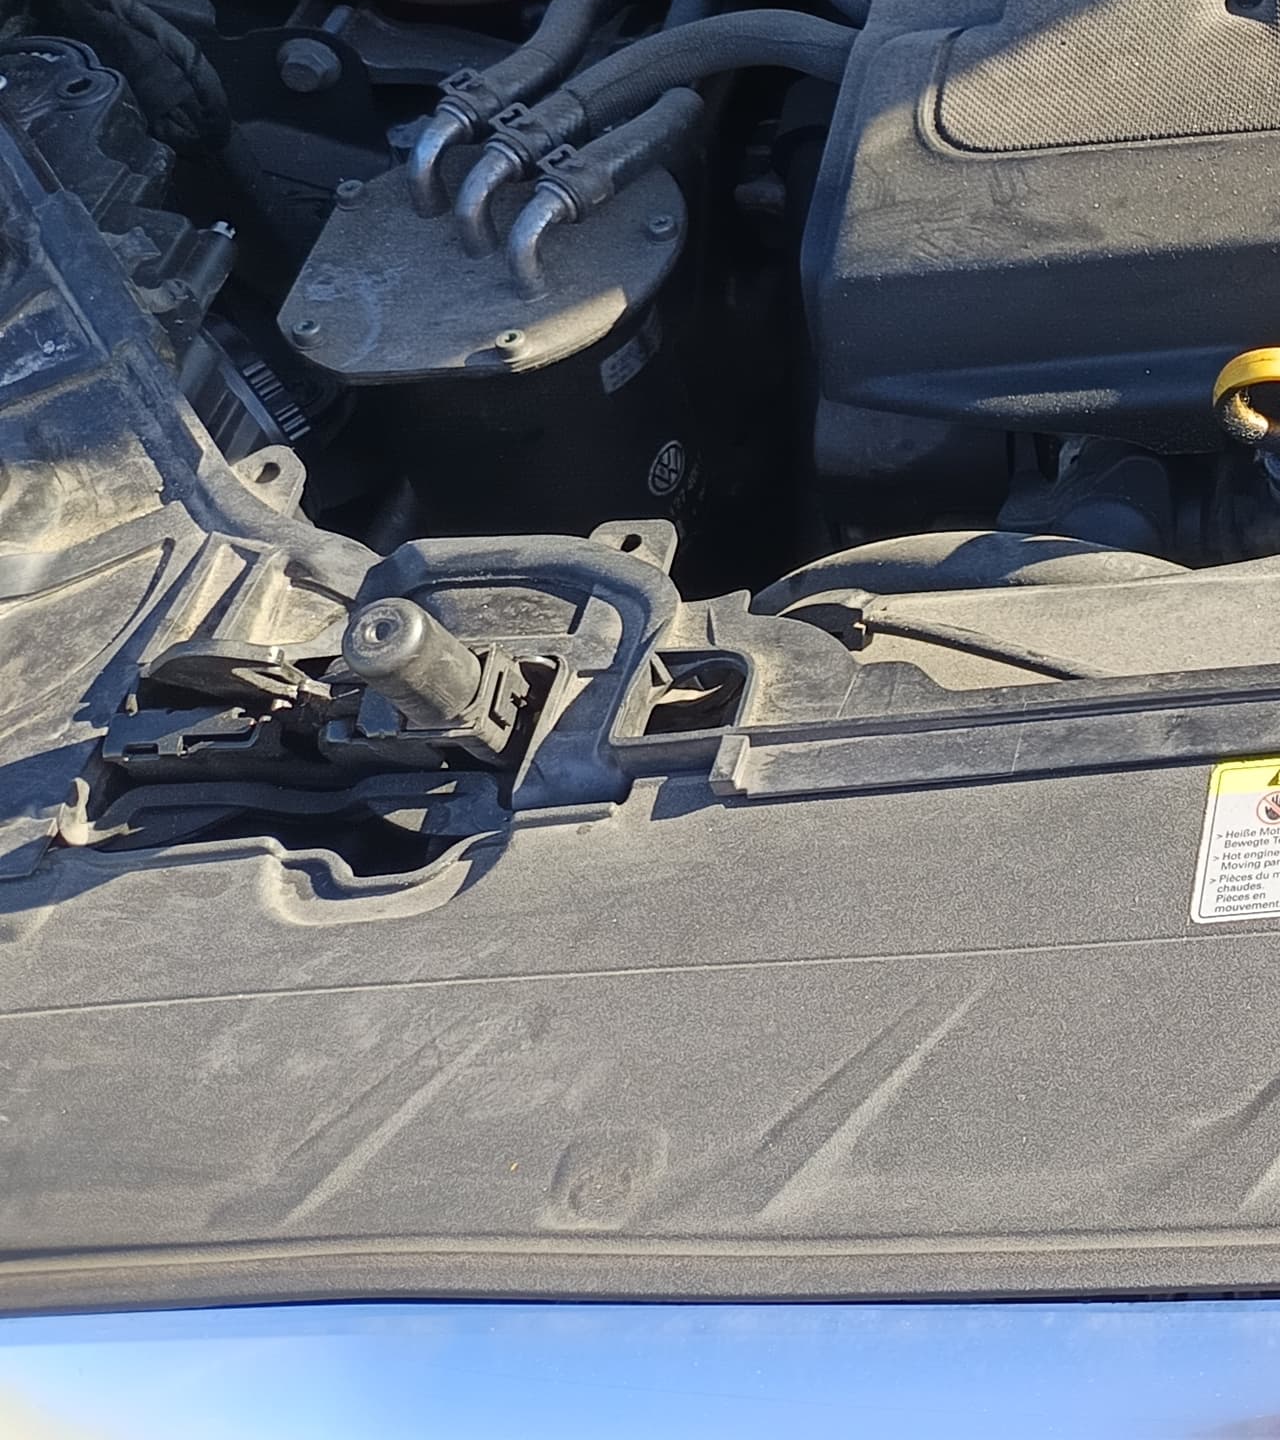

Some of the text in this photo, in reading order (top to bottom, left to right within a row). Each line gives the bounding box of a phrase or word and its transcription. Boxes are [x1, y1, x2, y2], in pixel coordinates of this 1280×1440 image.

[1226, 828, 1256, 839] Heiße
[1224, 838, 1269, 849] Bewegte
[1223, 852, 1241, 861] Hot
[1244, 849, 1280, 860] engine
[1221, 857, 1262, 871] Moving
[1219, 873, 1253, 884] Pièces
[1256, 871, 1269, 881] du
[1217, 882, 1264, 894] chaudes.
[1216, 892, 1265, 904] Pièces en
[1215, 899, 1280, 913] mouvement.
